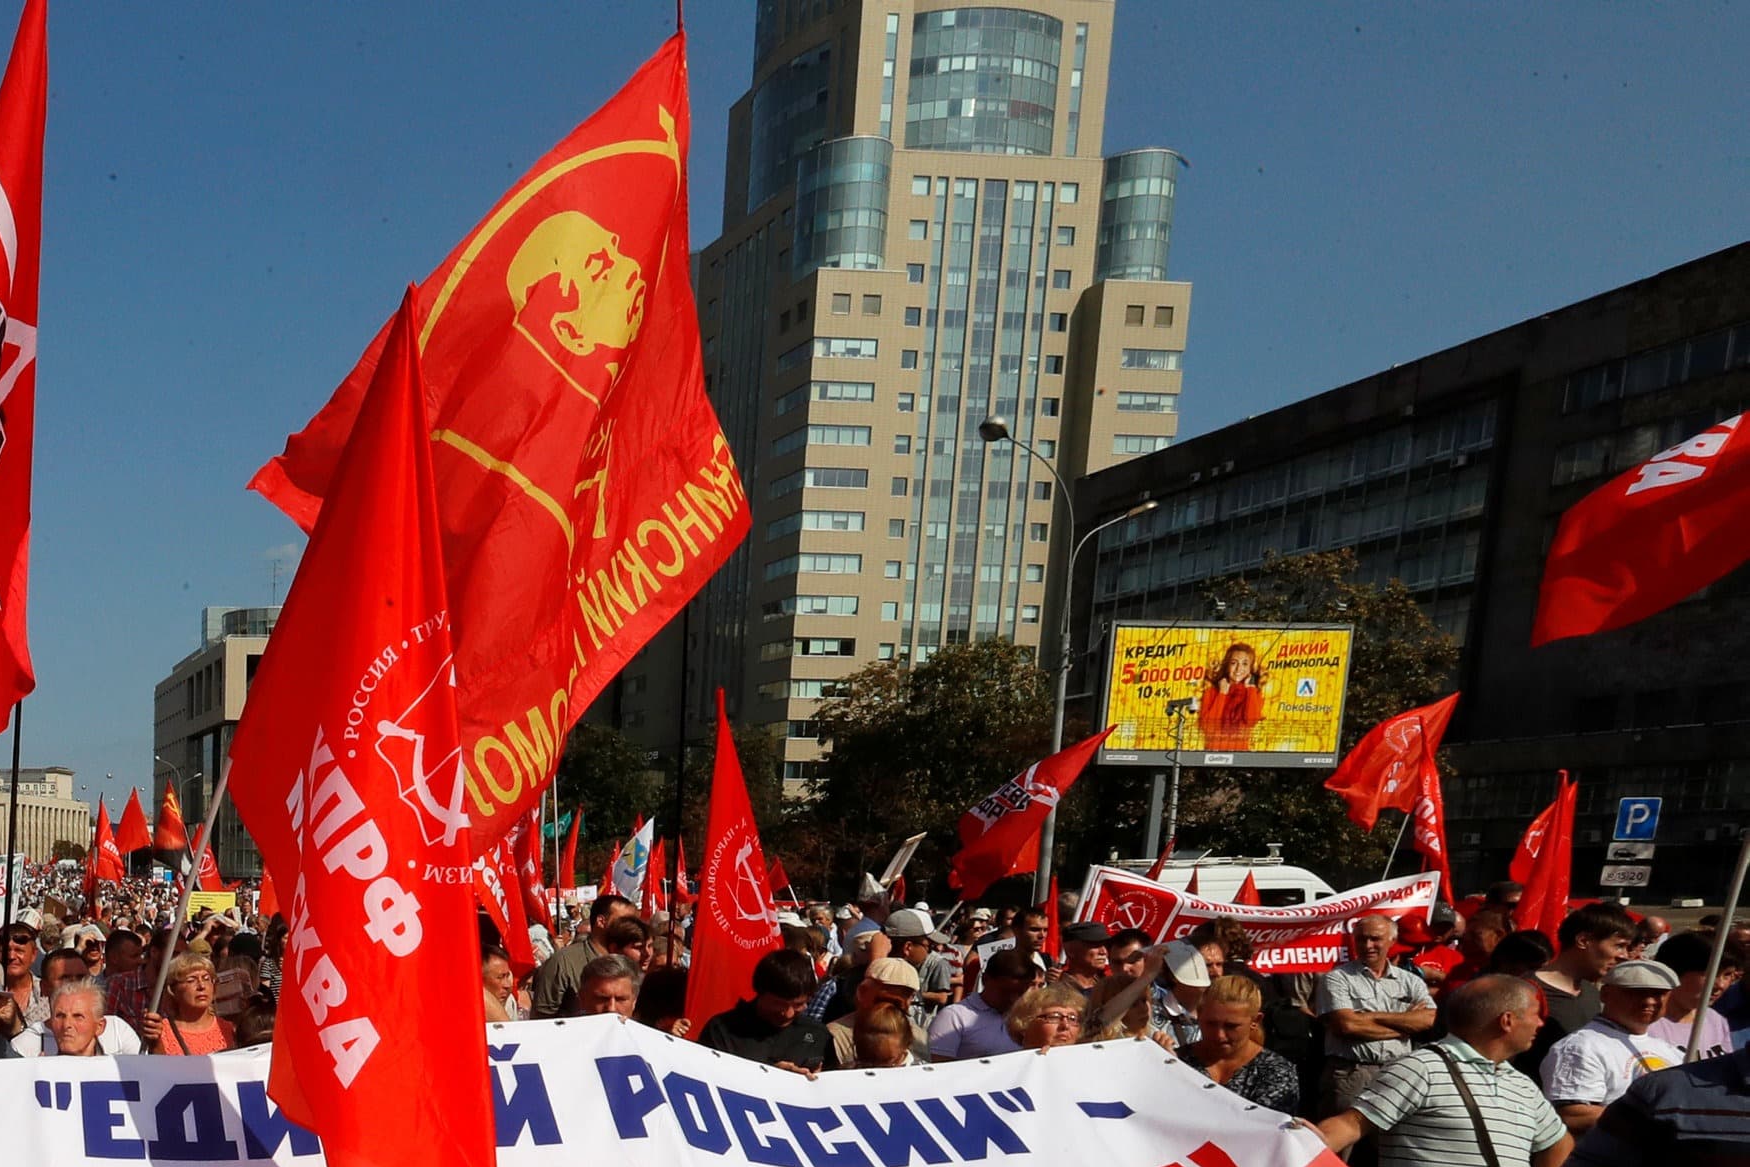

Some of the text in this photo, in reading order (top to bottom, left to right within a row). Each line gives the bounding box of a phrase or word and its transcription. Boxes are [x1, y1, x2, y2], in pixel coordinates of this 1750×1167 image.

[410, 610, 452, 643] ТРУ
[1125, 643, 1187, 659] КРЕДИТ
[1277, 640, 1330, 658] ДИКИЙ
[1267, 656, 1340, 670] ЛИМОНОПАД
[1625, 803, 1650, 835] P
[1250, 945, 1349, 969] ДЕЛЕНИЕ
[34, 1044, 563, 1161] "ЕДИЙ
